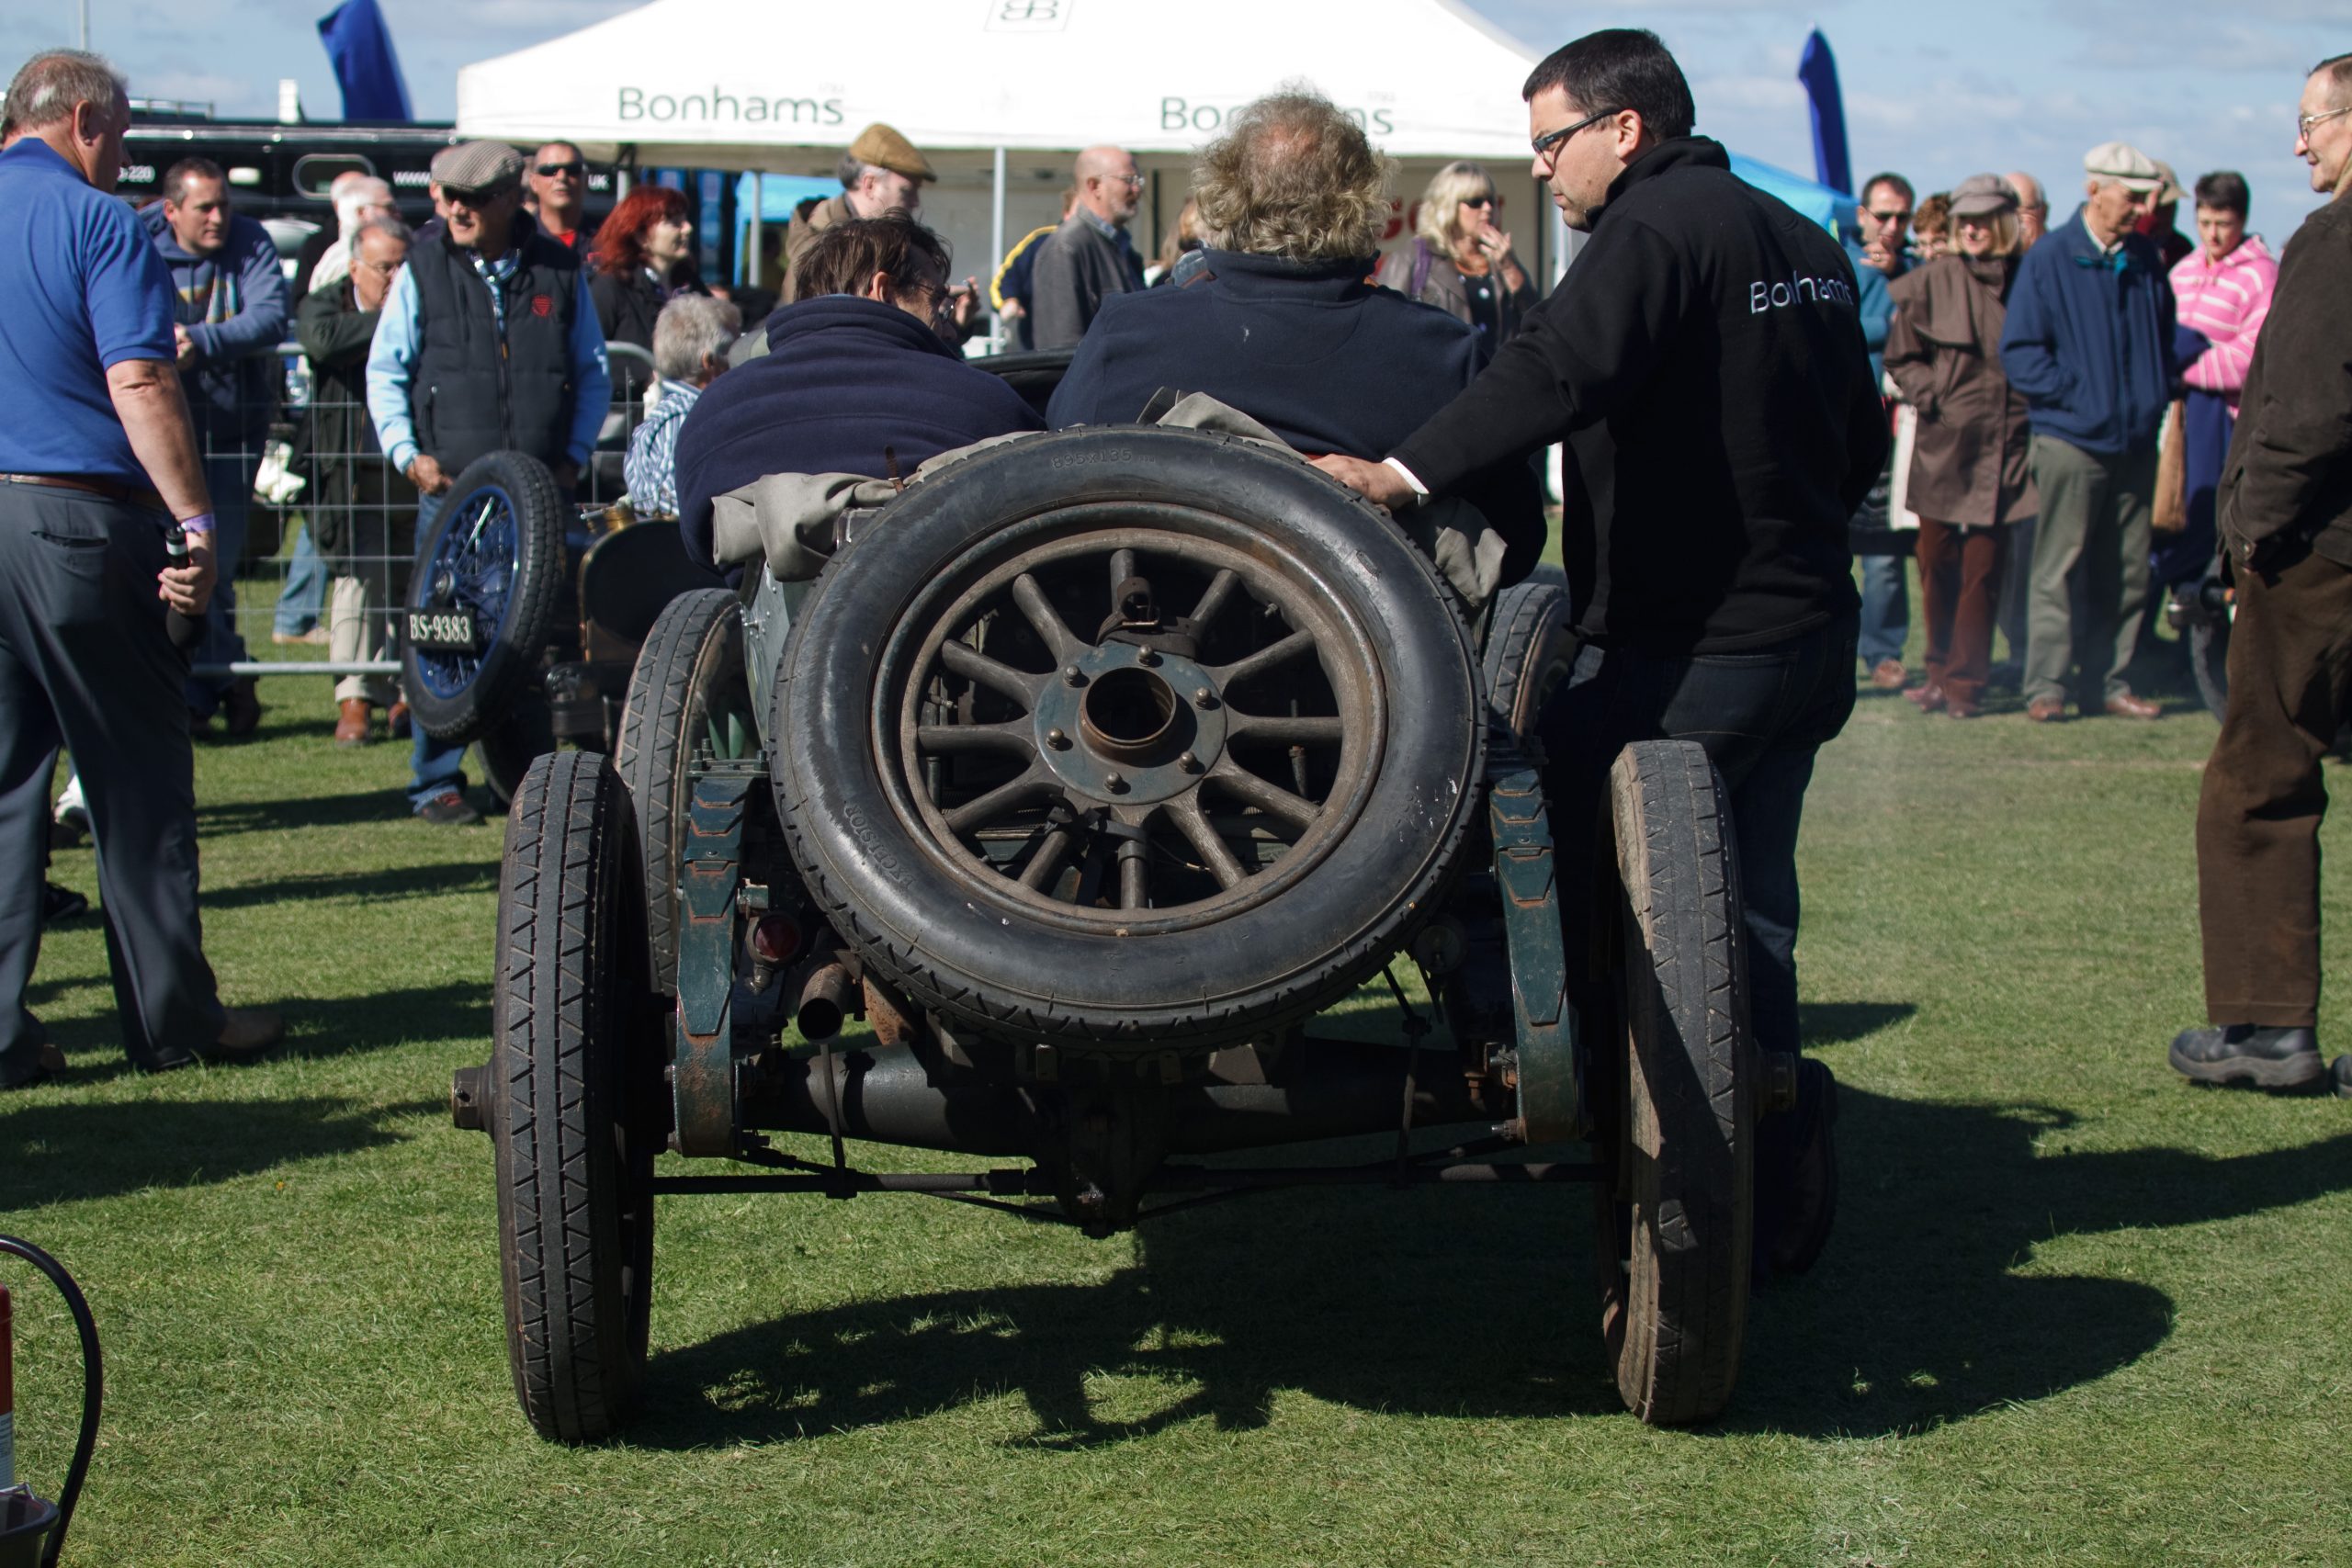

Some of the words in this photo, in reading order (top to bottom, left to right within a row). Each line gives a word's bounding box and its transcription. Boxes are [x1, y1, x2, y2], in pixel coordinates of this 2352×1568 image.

[618, 85, 844, 125] Bonhams
[409, 614, 471, 644] BS-9383
[843, 802, 916, 890] EXCELSIOR
